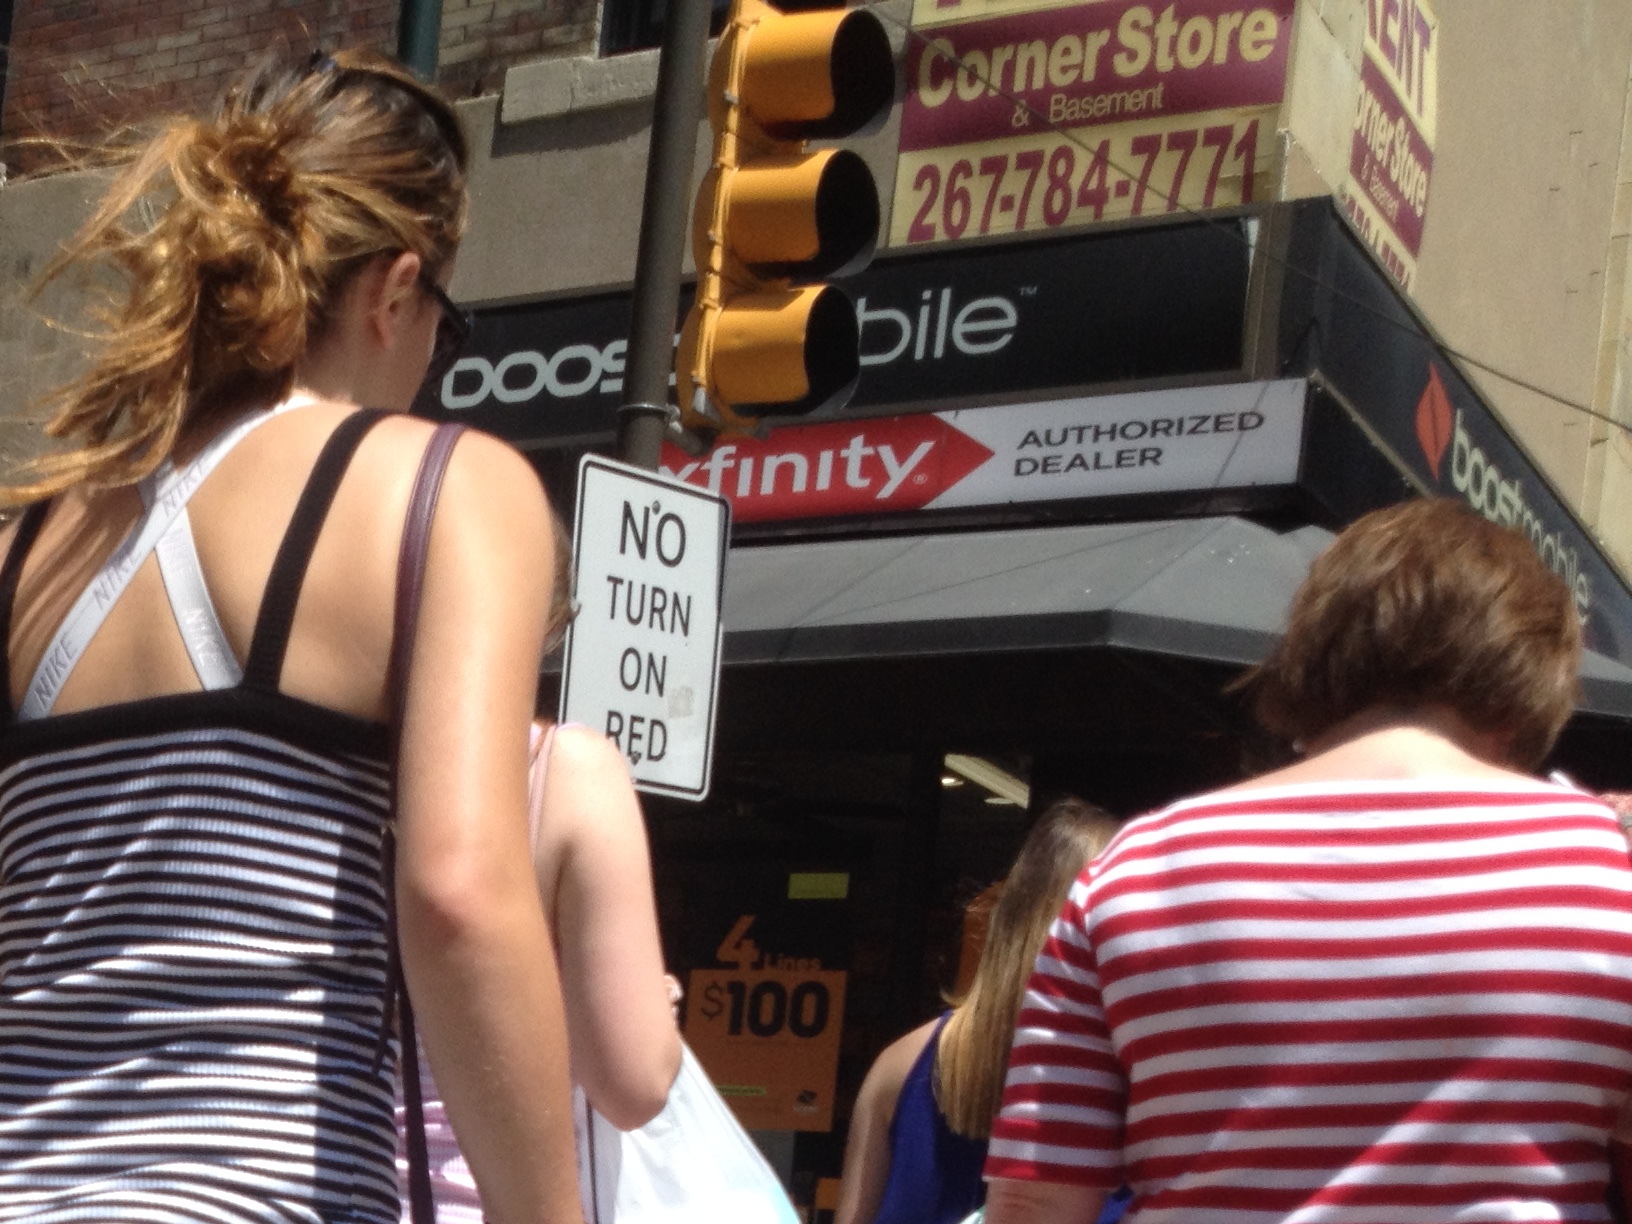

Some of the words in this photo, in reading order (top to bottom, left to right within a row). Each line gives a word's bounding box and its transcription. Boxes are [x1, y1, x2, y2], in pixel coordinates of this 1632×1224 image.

[917, 26, 1111, 109] Corner
[1112, 5, 1279, 79] Store
[1368, 0, 1430, 118] ENT
[1011, 102, 1029, 128] &
[1047, 82, 1166, 124] Basement
[1354, 80, 1395, 169] orner
[1389, 116, 1428, 219] Store
[907, 119, 1261, 245] 267-784-7771
[1016, 410, 1265, 451] AUTHORIZED
[1013, 447, 1163, 478] DEALER
[619, 500, 687, 568] NO
[606, 575, 693, 638] TURN
[34, 632, 76, 708] NIKE
[619, 647, 667, 698] ON
[605, 709, 668, 763] RED
[716, 914, 760, 971] 4
[700, 979, 831, 1039] $100
